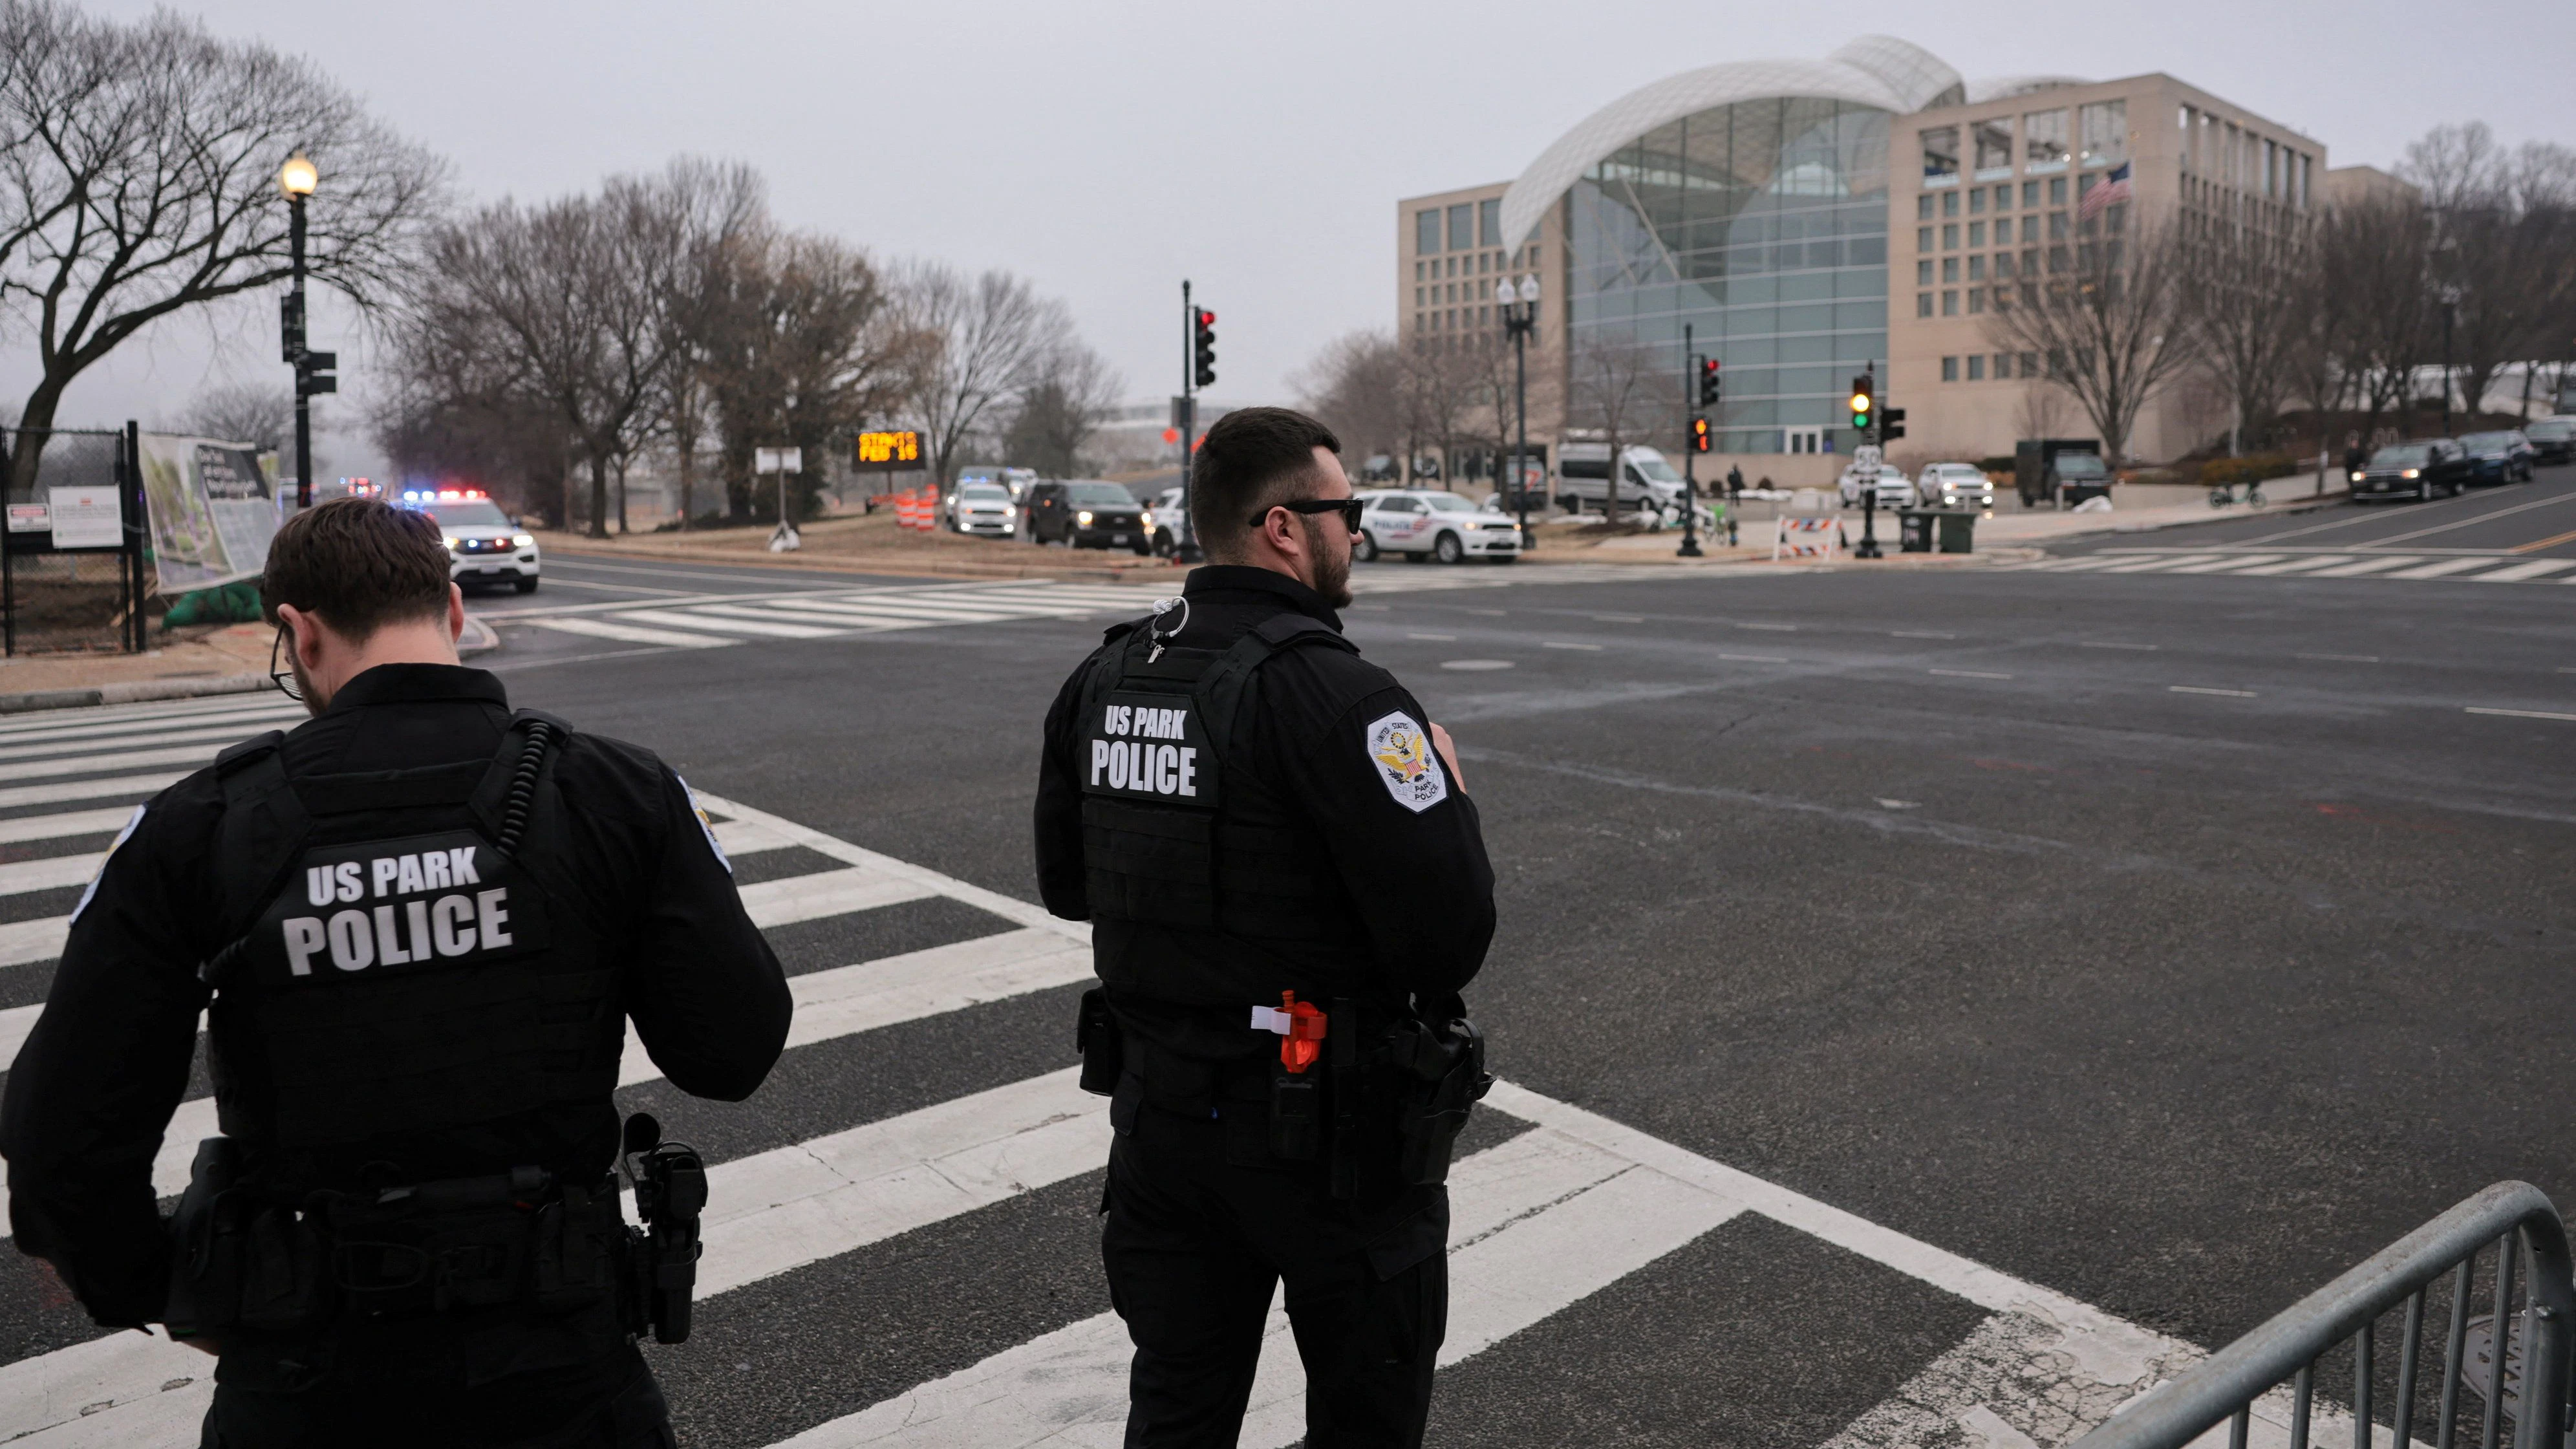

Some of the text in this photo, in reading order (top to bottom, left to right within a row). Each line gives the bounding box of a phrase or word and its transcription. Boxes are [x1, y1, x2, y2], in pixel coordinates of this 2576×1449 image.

[1858, 451, 1880, 467] 50
[1104, 705, 1188, 740] US PARK
[1376, 727, 1390, 743] UNITED
[1091, 739, 1196, 797] POLICE
[1415, 780, 1432, 792] PARK
[1415, 783, 1439, 800] POLICE
[307, 846, 480, 906] US PARK
[283, 887, 513, 976] POLICE
